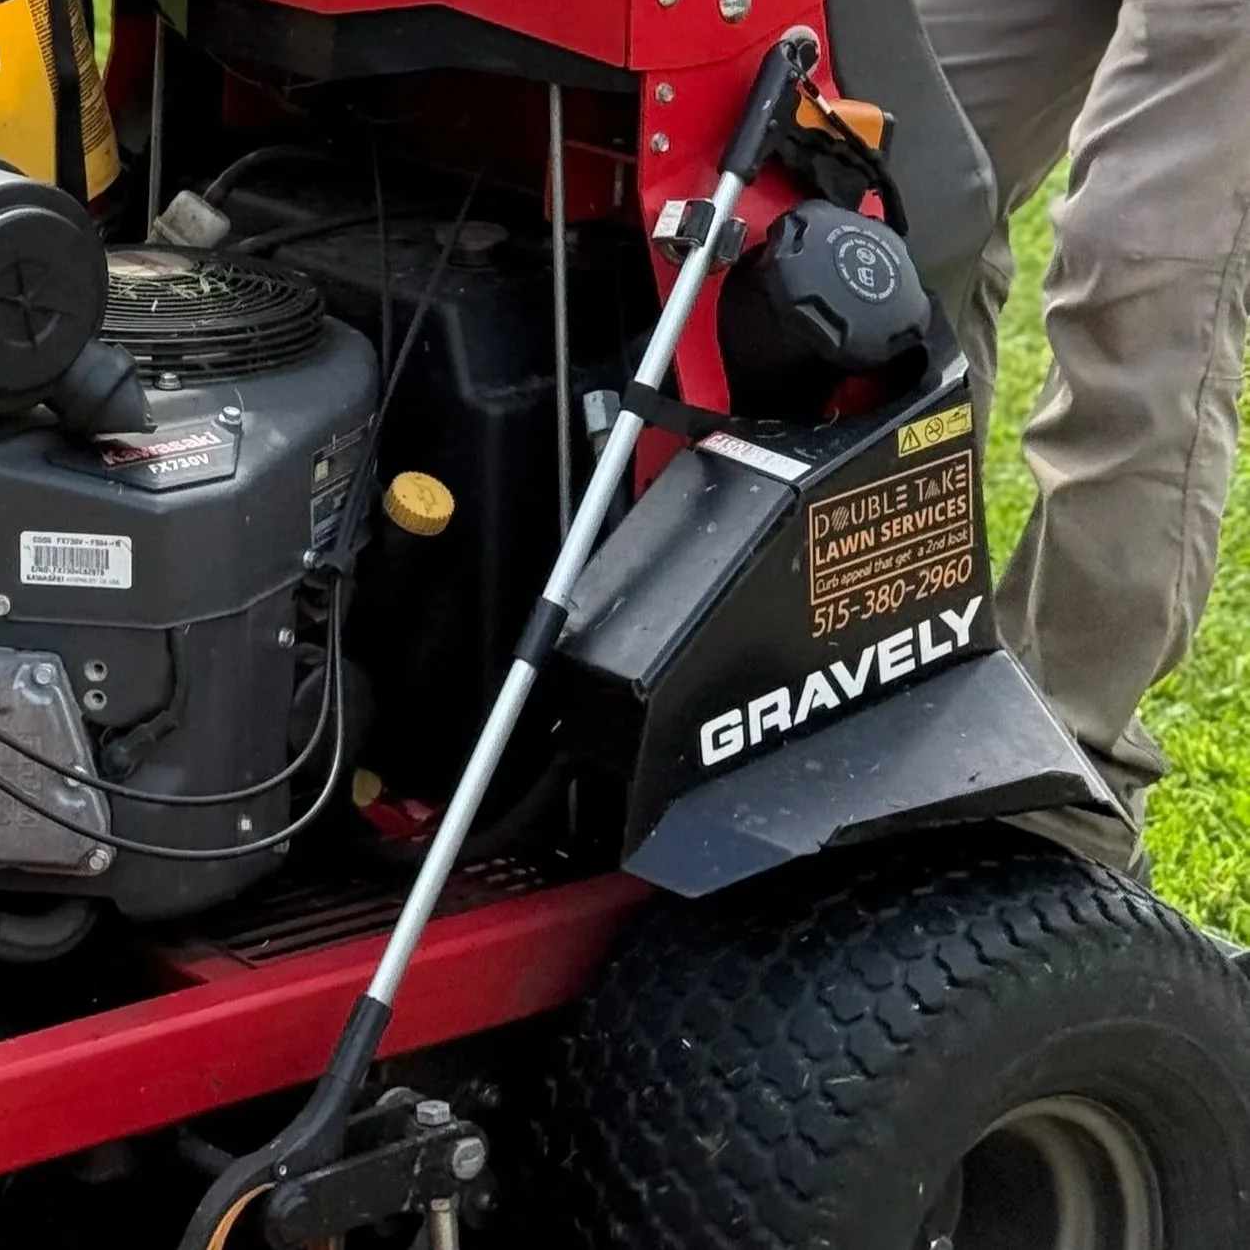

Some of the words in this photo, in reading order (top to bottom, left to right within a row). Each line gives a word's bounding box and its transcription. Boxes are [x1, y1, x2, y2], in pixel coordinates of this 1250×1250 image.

[102, 431, 222, 465] Kawasaki
[148, 452, 209, 474] FX730V
[814, 484, 908, 539] DOUBLE
[914, 463, 967, 502] TAKE
[815, 526, 875, 566] LAWN
[880, 494, 967, 542] SERVICES
[812, 554, 972, 638] 515-380-2960
[815, 574, 840, 594] Curb
[840, 562, 872, 586] appeal
[874, 557, 894, 573] that
[926, 534, 946, 555] 2nd
[700, 595, 983, 766] GRAVELY
